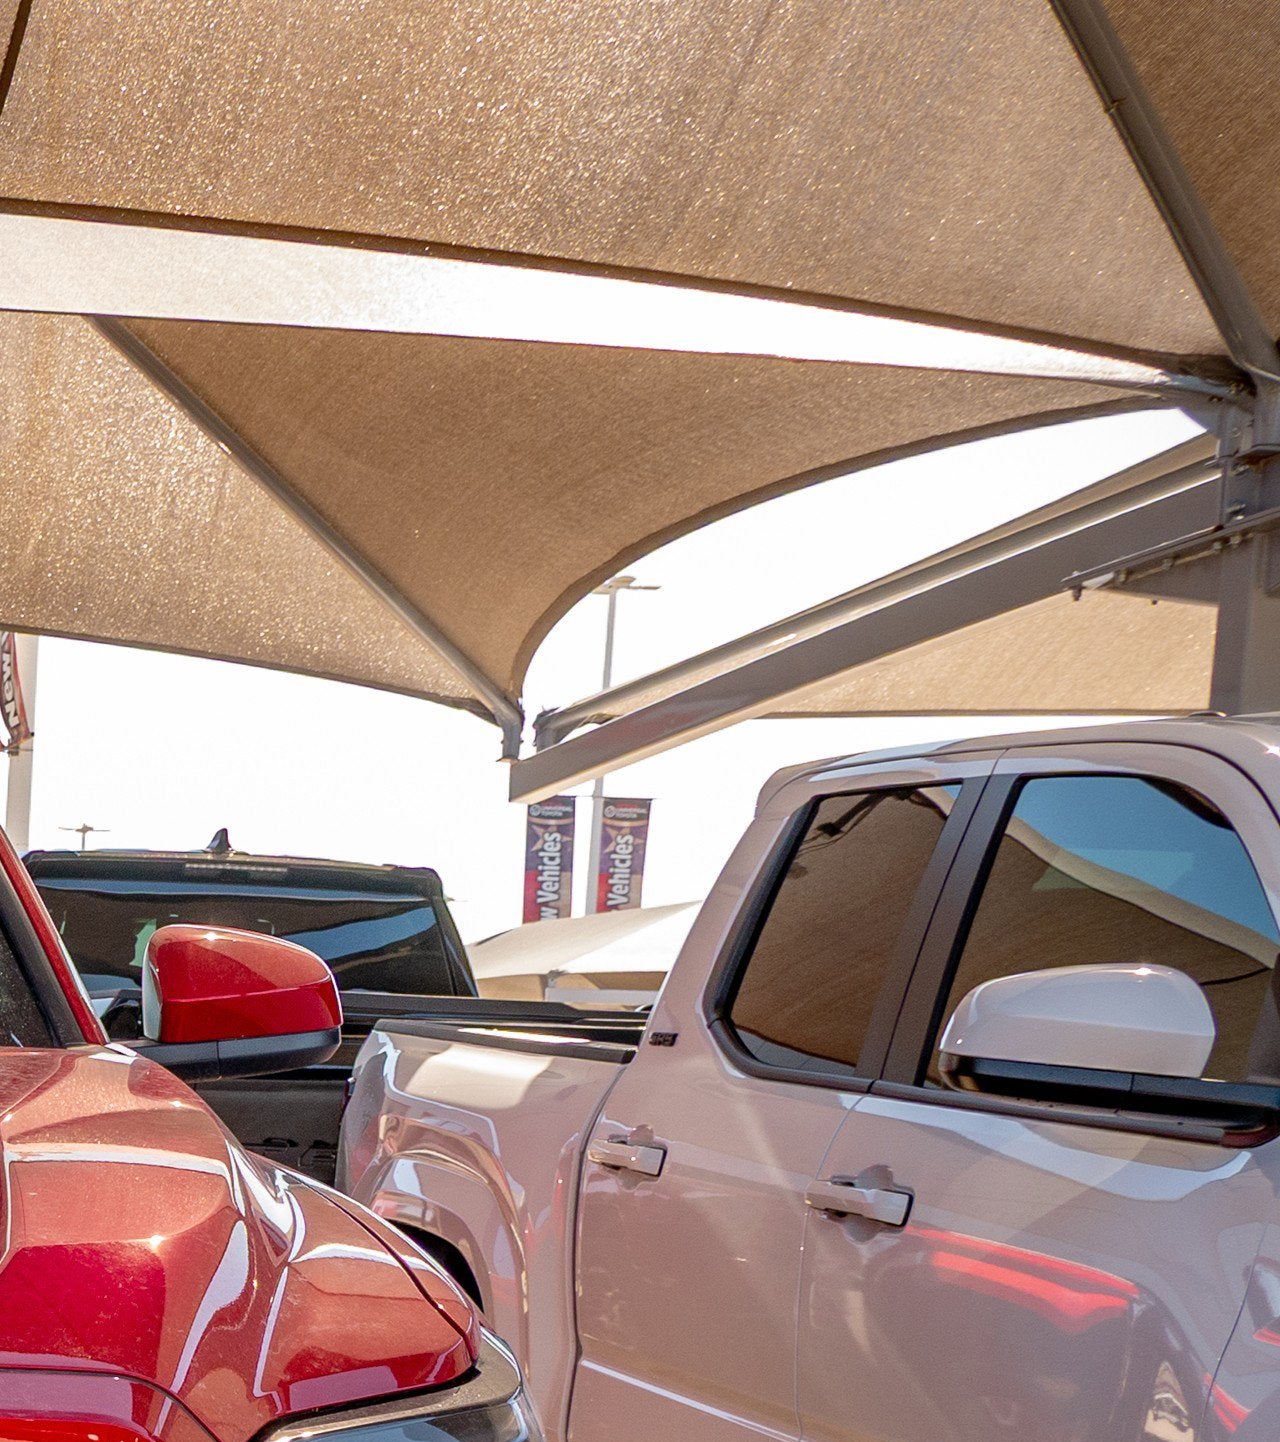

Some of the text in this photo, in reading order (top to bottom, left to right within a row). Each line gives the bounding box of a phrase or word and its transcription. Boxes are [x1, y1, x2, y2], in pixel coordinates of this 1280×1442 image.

[2, 653, 20, 727] New
[536, 832, 561, 903] Vehicles
[606, 834, 634, 906] Vehicles
